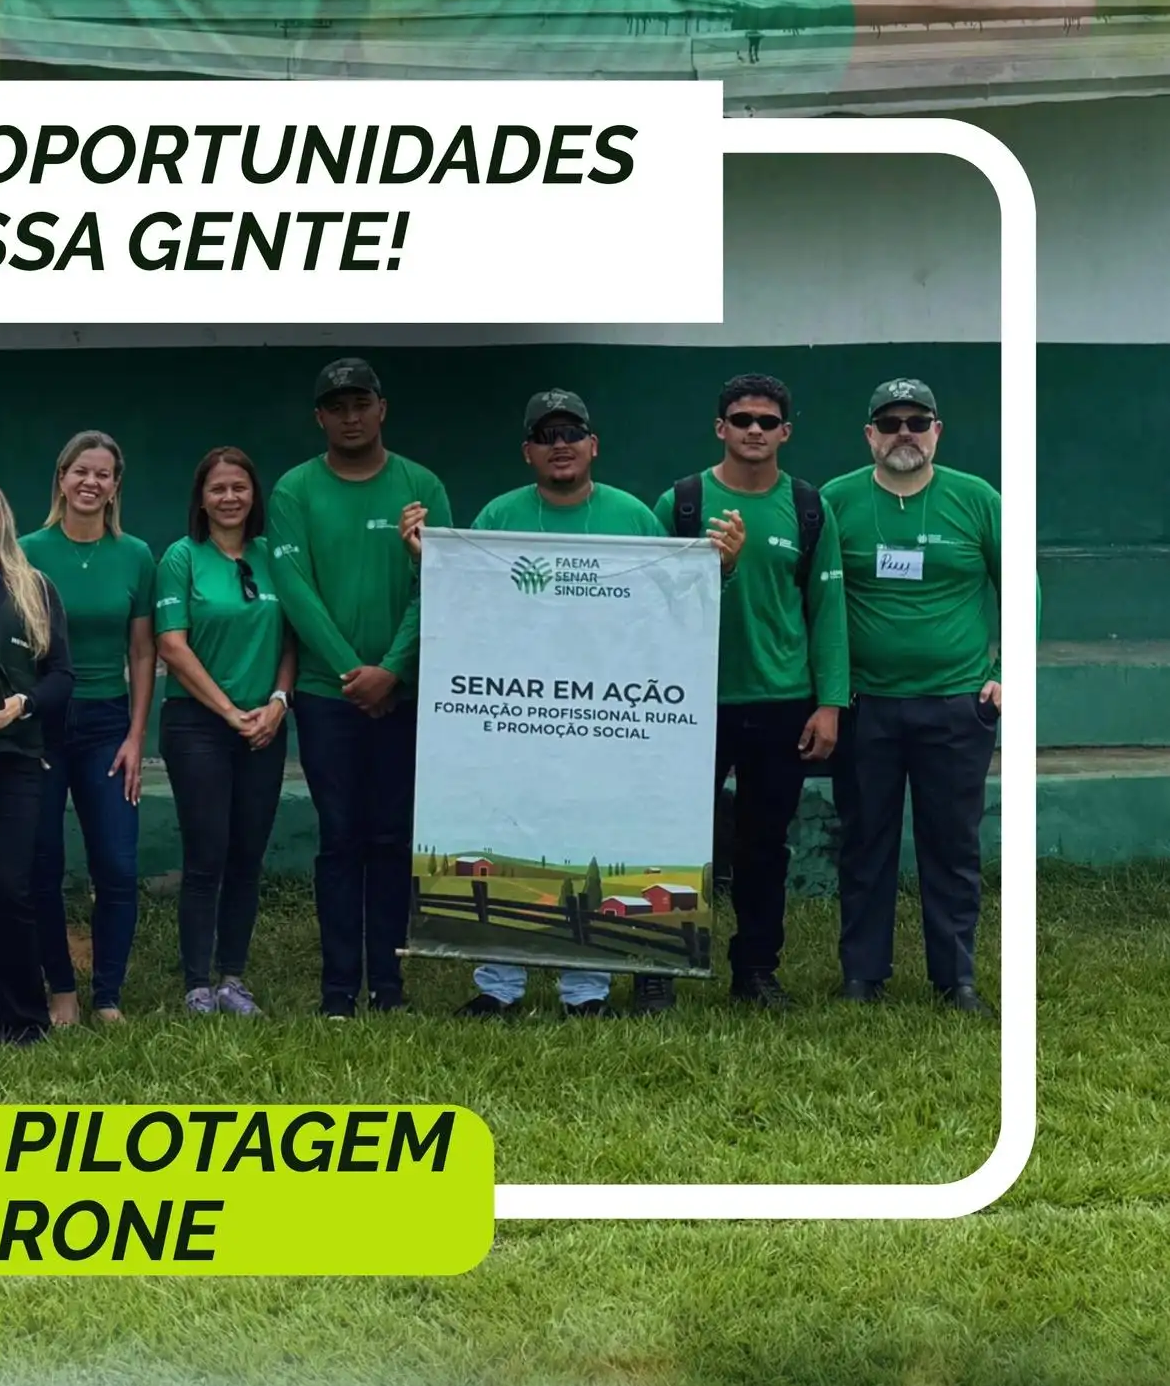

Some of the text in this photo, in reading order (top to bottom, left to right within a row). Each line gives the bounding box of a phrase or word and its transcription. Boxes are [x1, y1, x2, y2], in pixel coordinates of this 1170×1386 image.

[555, 557, 600, 569] FAEMA
[554, 571, 598, 583] SENAR
[554, 585, 631, 598] SINDICATOS
[451, 675, 686, 708] SENAR EM AÇÃO
[434, 702, 698, 725] FORMAÇÃO PROFISSIONAL RURAL
[483, 721, 650, 739] E PROMOÇÃO SOCIAL
